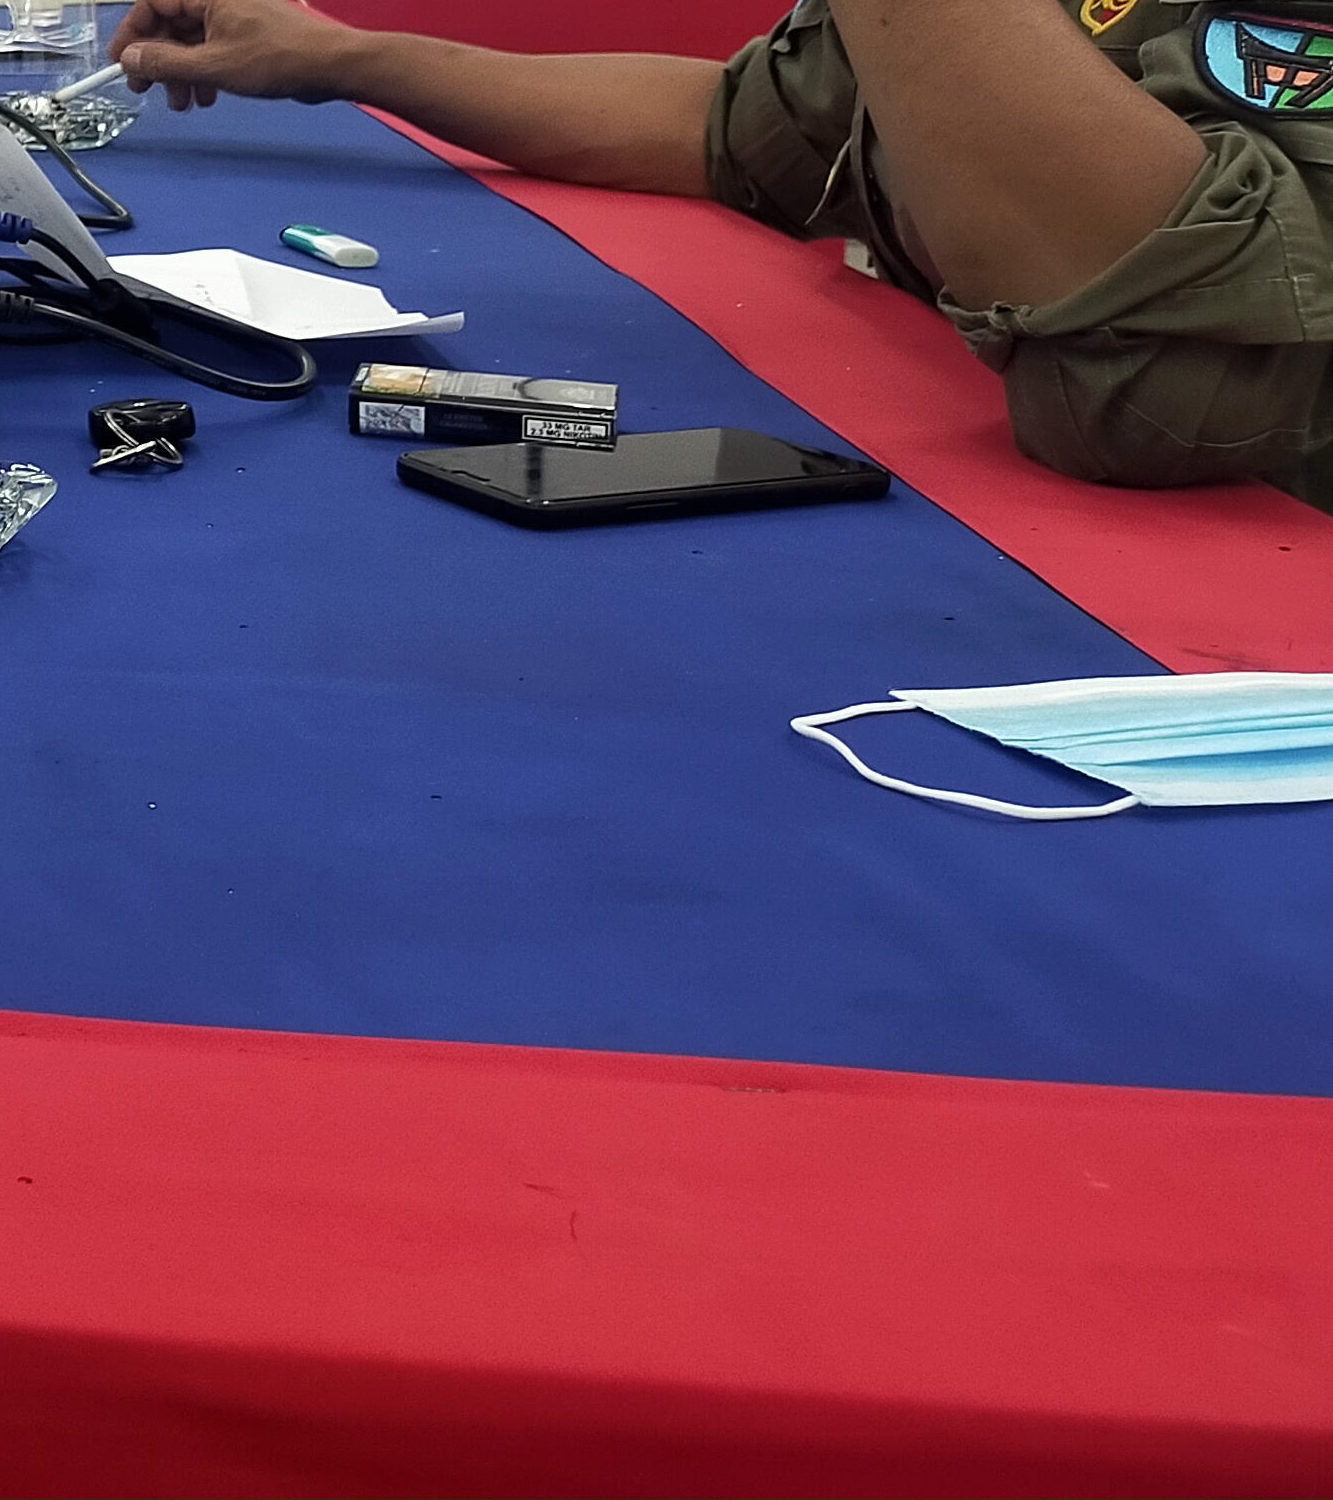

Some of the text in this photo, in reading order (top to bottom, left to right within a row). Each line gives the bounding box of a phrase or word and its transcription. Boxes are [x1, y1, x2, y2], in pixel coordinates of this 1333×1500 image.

[542, 421, 591, 432] 33 MG TAR
[546, 429, 561, 438] MG
